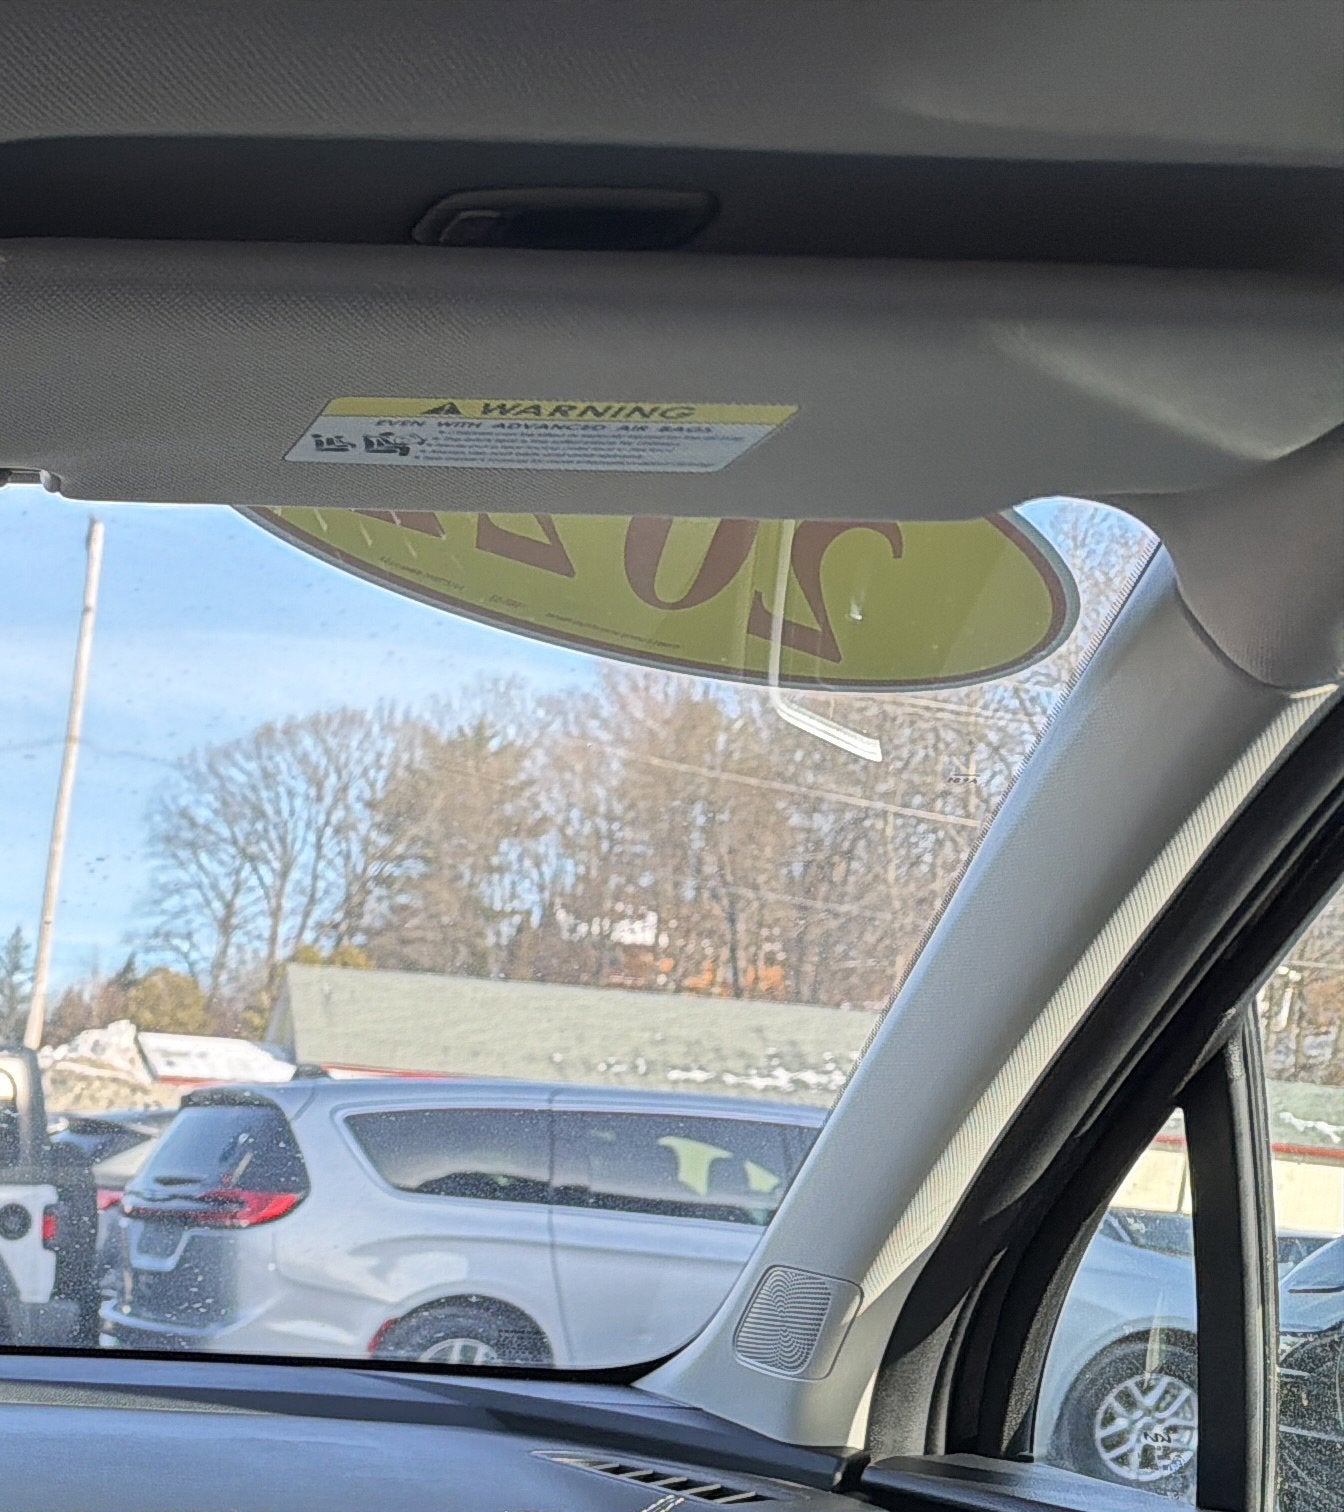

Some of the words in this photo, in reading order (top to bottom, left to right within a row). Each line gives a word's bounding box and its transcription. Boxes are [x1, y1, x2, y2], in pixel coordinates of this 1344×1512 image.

[481, 402, 696, 420] WARNING
[437, 421, 482, 430] WITH
[493, 422, 610, 432] ADVANCED
[618, 424, 651, 432] AIR
